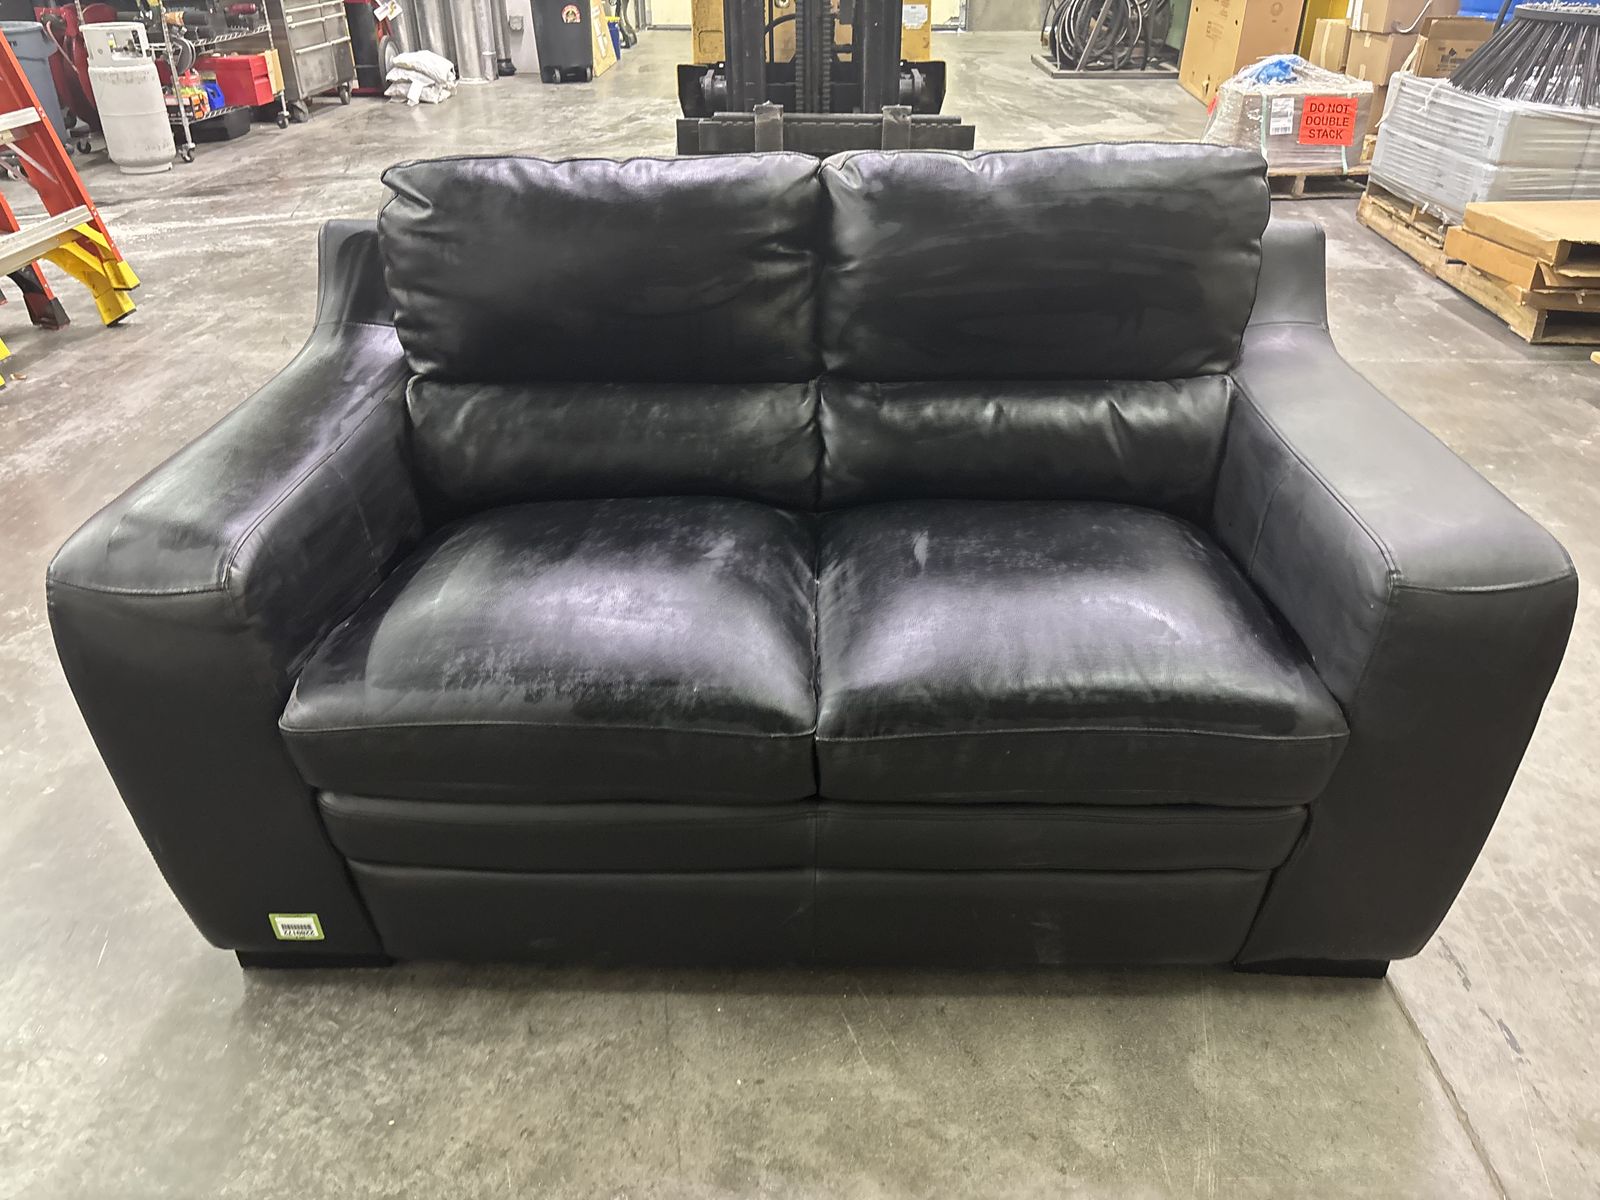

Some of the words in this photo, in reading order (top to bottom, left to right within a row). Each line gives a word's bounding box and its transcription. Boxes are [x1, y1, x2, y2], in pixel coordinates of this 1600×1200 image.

[1309, 103, 1325, 113] DO
[1327, 103, 1350, 114] NOT
[1305, 116, 1350, 127] DOUBLE
[1308, 128, 1344, 140] STACK
